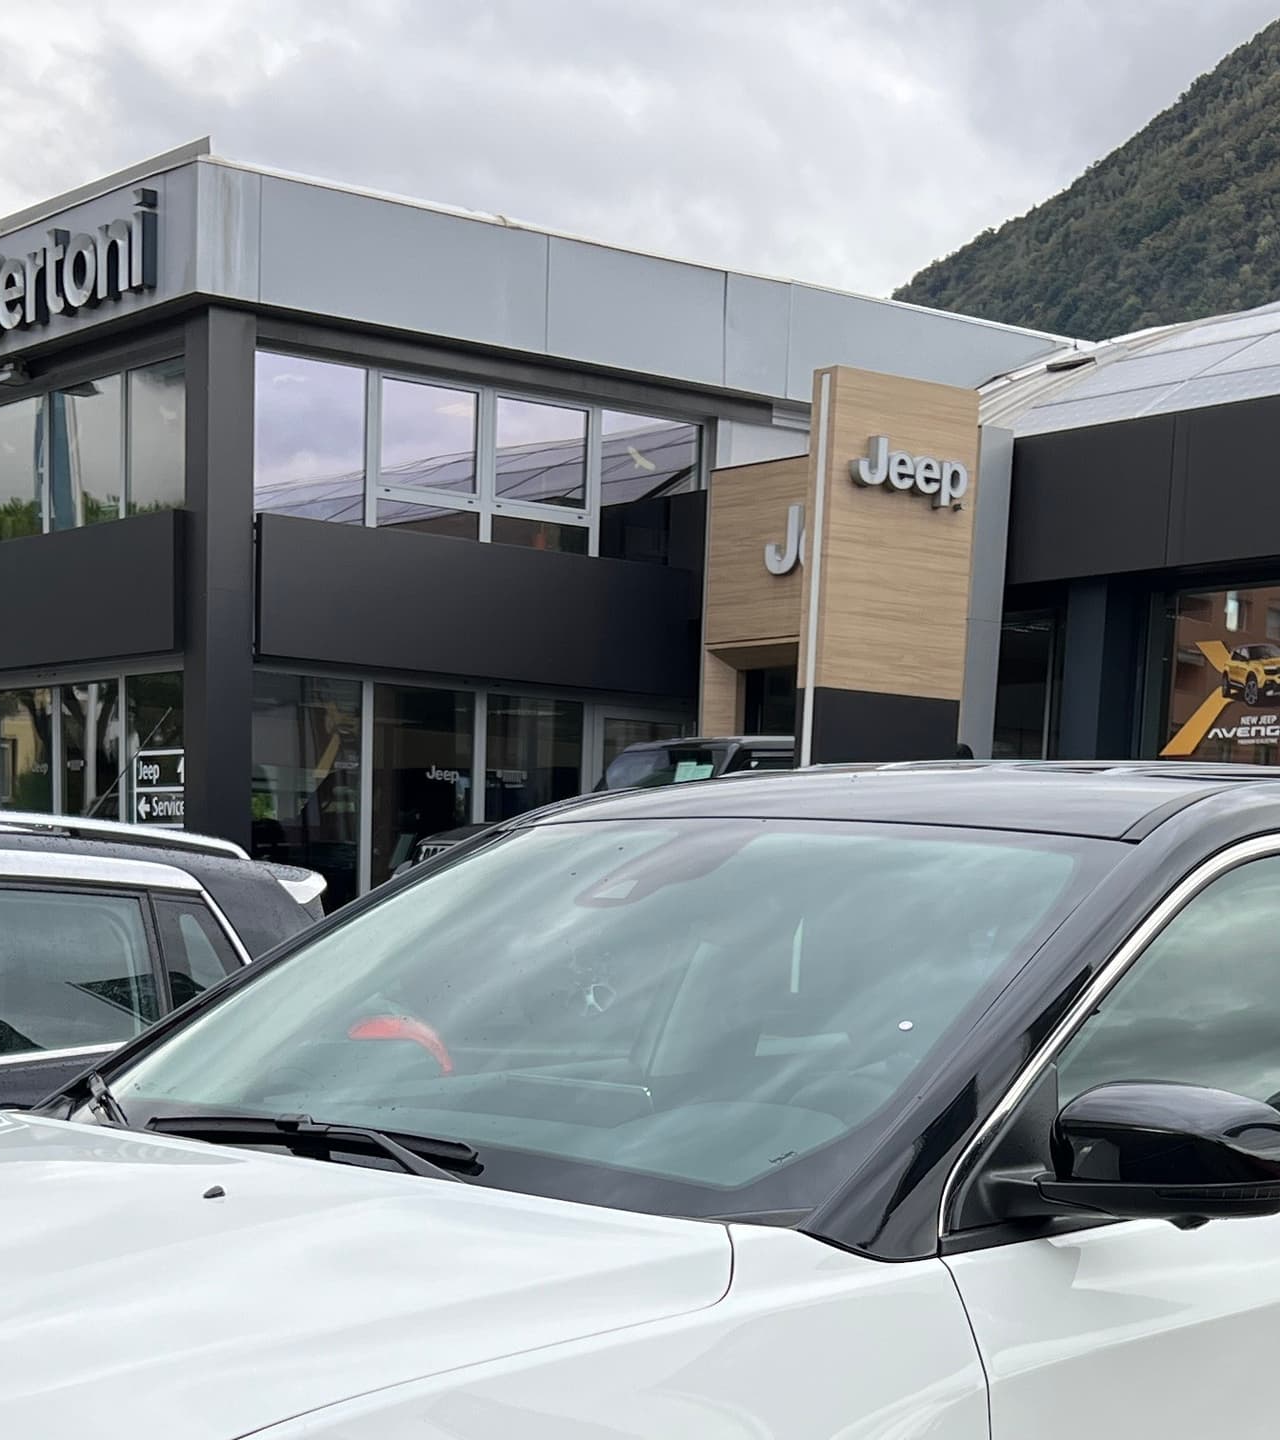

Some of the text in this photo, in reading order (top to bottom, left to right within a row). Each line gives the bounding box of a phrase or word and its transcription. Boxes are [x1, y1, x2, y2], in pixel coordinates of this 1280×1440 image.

[849, 434, 968, 509] Jeep
[1258, 714, 1277, 725] JEEP
[138, 760, 160, 784] Jeep
[425, 765, 460, 785] Jeep
